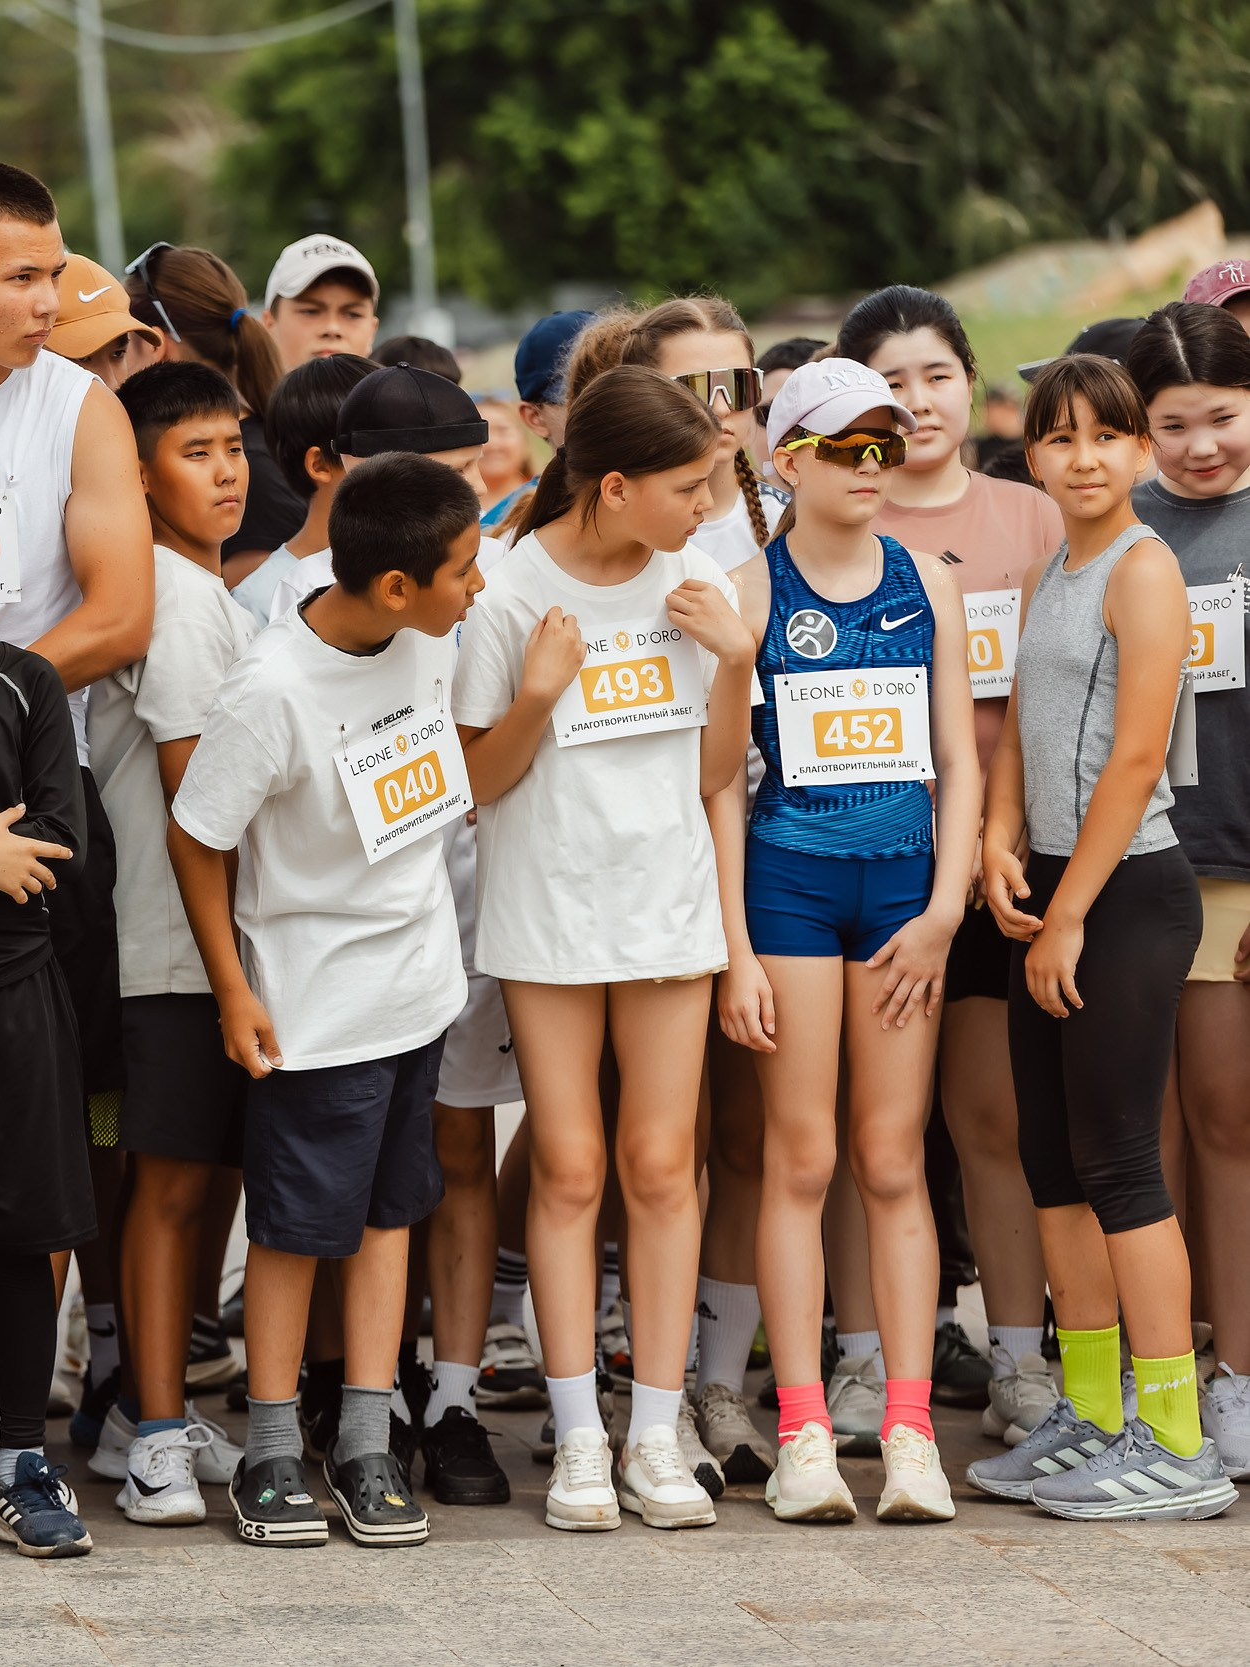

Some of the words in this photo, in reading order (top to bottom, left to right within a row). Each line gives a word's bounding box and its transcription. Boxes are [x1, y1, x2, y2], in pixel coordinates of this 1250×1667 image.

[636, 628, 682, 646] D'ORO
[592, 663, 664, 705] 493
[1206, 669, 1231, 679] ЗАБЕГ
[790, 685, 845, 702] LEONE
[873, 682, 916, 696] D'ORO
[371, 719, 384, 732] WE
[383, 705, 415, 726] BELONG.
[571, 708, 669, 733] БЛАГОТВОРИТЕЛЬНЫЙ
[669, 706, 693, 718] ЗАБЕГ
[823, 713, 895, 750] 452
[350, 746, 393, 776] LEONE
[411, 719, 444, 746] D'ORO
[799, 760, 897, 774] БЛАГОТВОРИТЕЛЬНЫЙ
[897, 760, 919, 769] ЗАБЕГ
[383, 760, 438, 814] 040
[376, 802, 445, 847] БЛАГОТВОРИТЕЛЬНЫЙ
[444, 793, 461, 810] ЗАБЕГ
